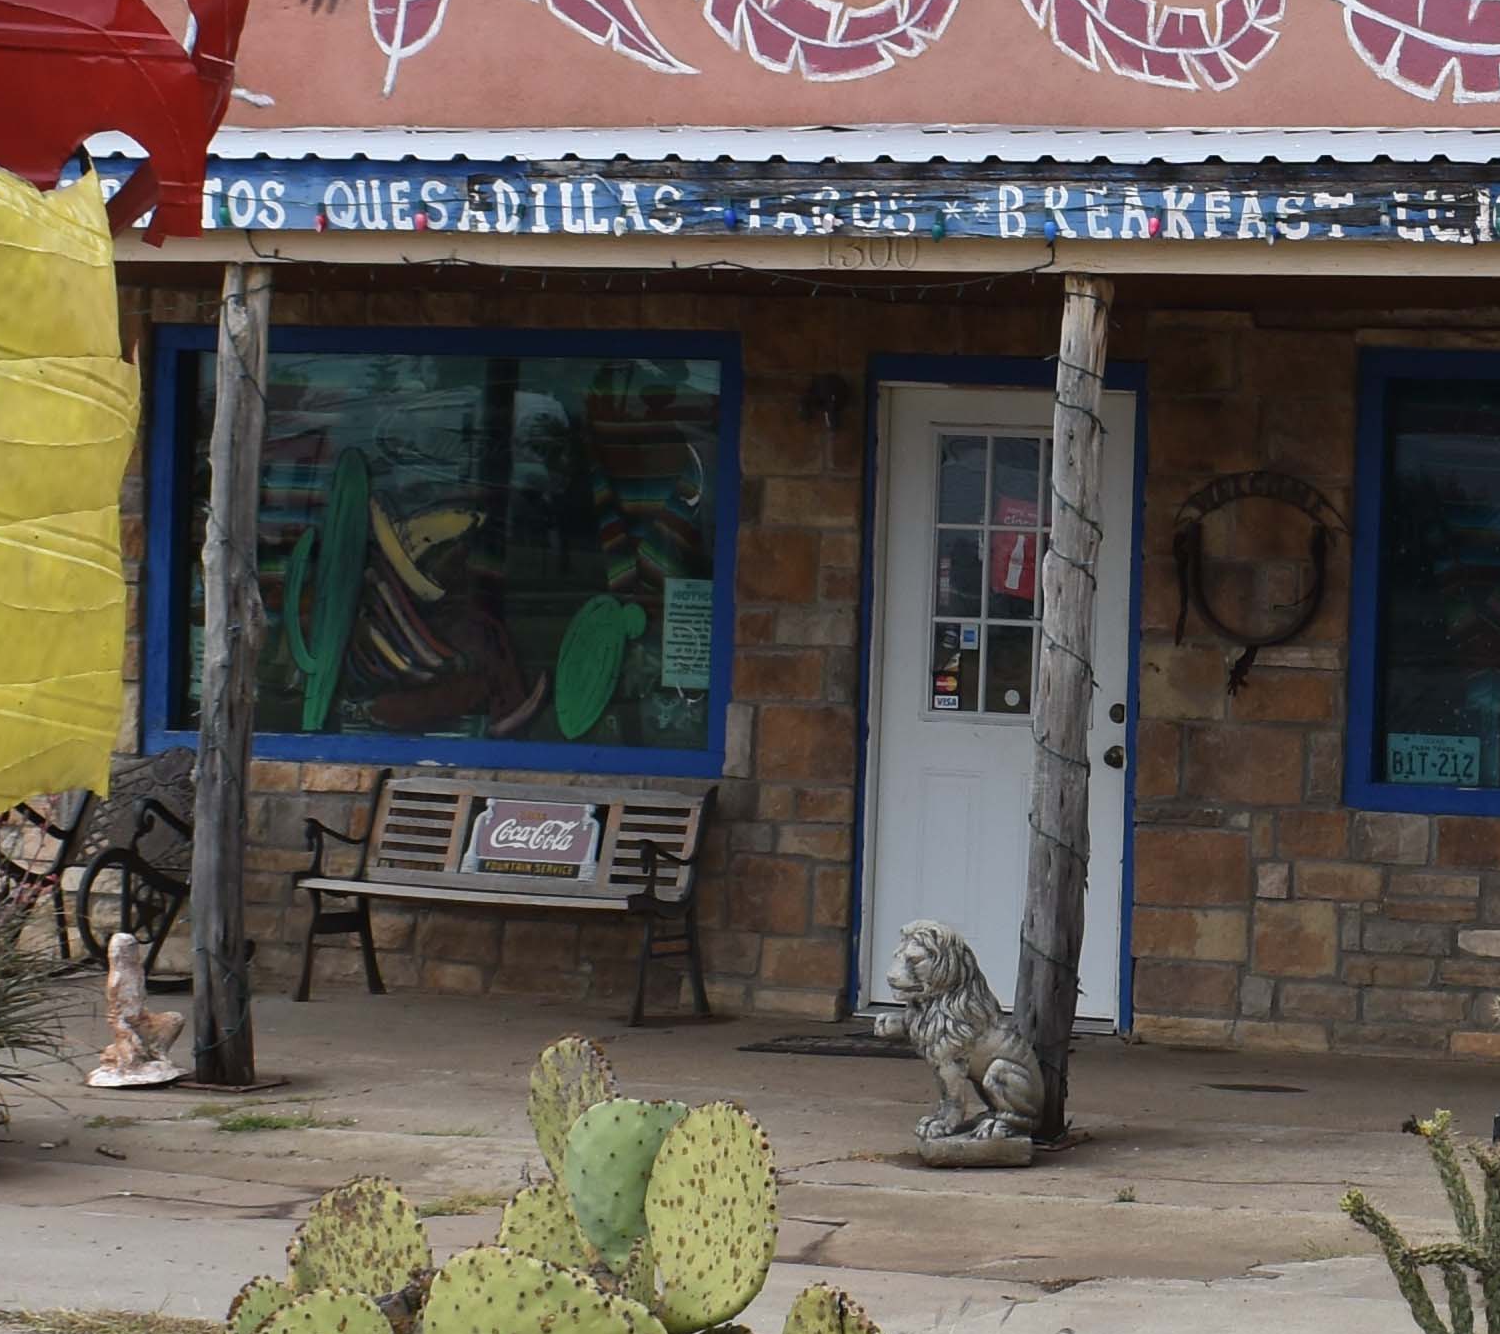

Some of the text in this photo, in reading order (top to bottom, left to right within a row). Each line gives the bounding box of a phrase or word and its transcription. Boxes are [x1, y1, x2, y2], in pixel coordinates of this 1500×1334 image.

[323, 177, 686, 234] QUESADILLAS
[998, 184, 1355, 239] BREAKFAST
[936, 697, 957, 708] VISA
[490, 818, 581, 851] Coca-Cola
